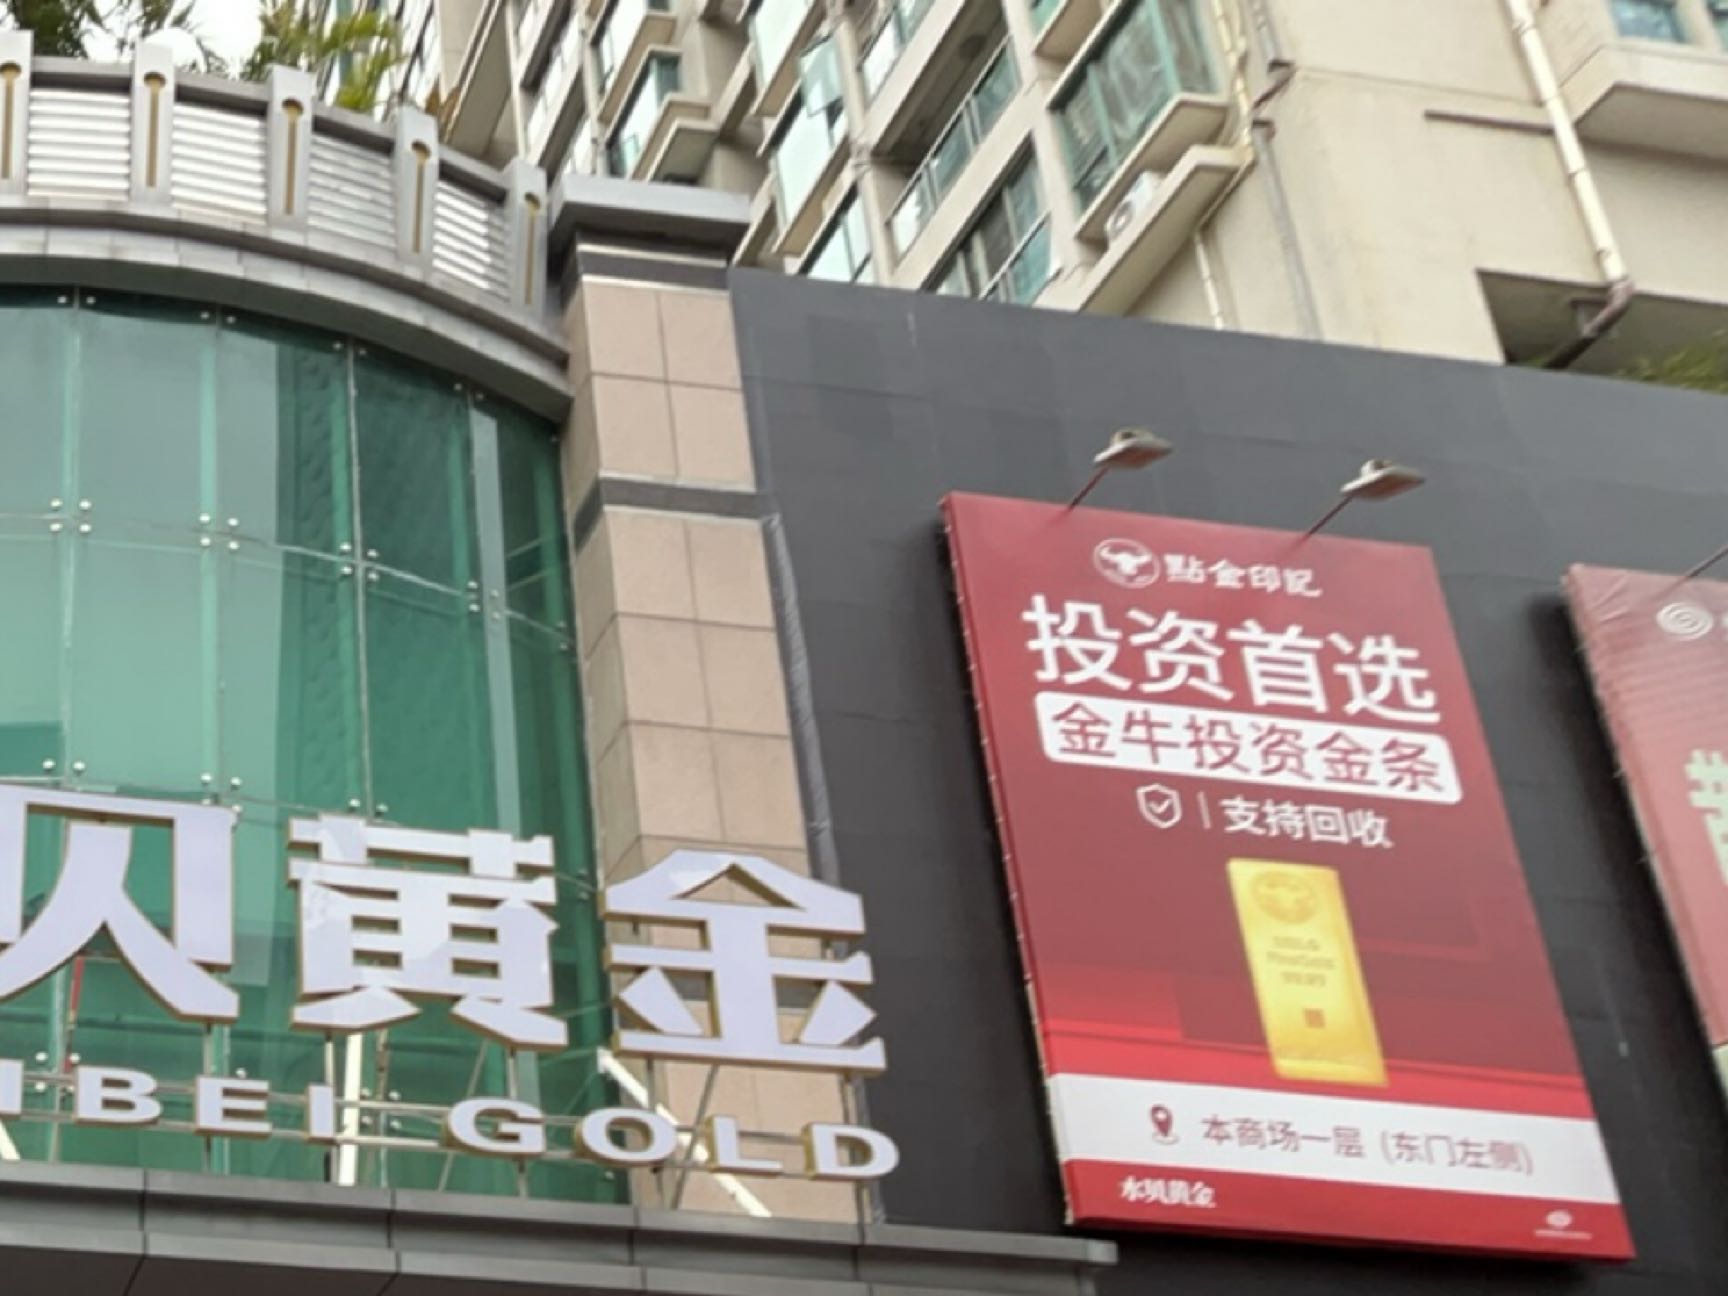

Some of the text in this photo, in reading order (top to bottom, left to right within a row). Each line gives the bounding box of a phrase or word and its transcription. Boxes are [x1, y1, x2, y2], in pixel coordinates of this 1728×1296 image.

[1164, 553, 1322, 598] 點金印記
[1021, 594, 1442, 724] 投资首选
[1049, 702, 1446, 796] 金牛投资金条
[1222, 796, 1393, 849] 支持回收
[446, 1095, 902, 1180] GOLD
